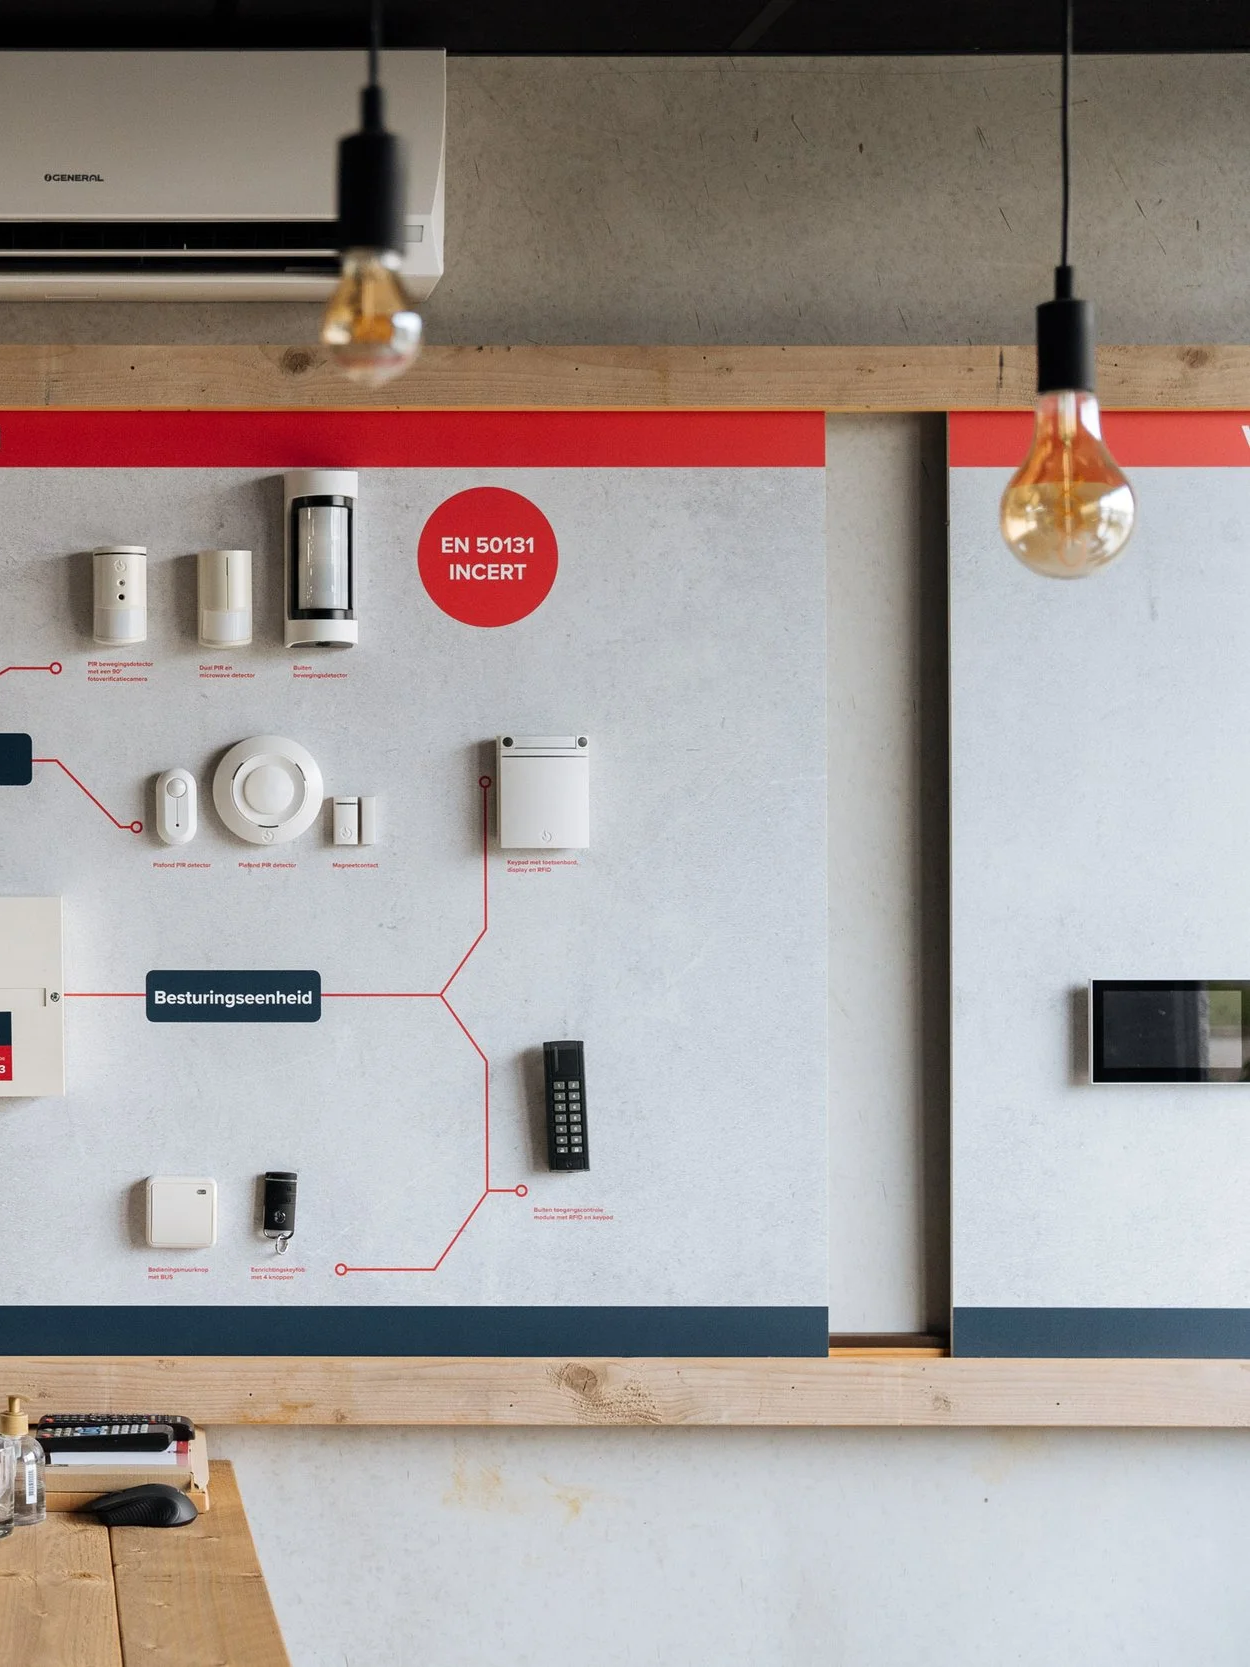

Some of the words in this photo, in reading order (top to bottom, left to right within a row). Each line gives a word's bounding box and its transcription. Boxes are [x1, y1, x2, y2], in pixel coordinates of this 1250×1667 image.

[441, 537, 469, 553] EN
[476, 537, 534, 553] 50131
[449, 564, 527, 580] INCERT
[154, 990, 313, 1008] Besturingseenheid
